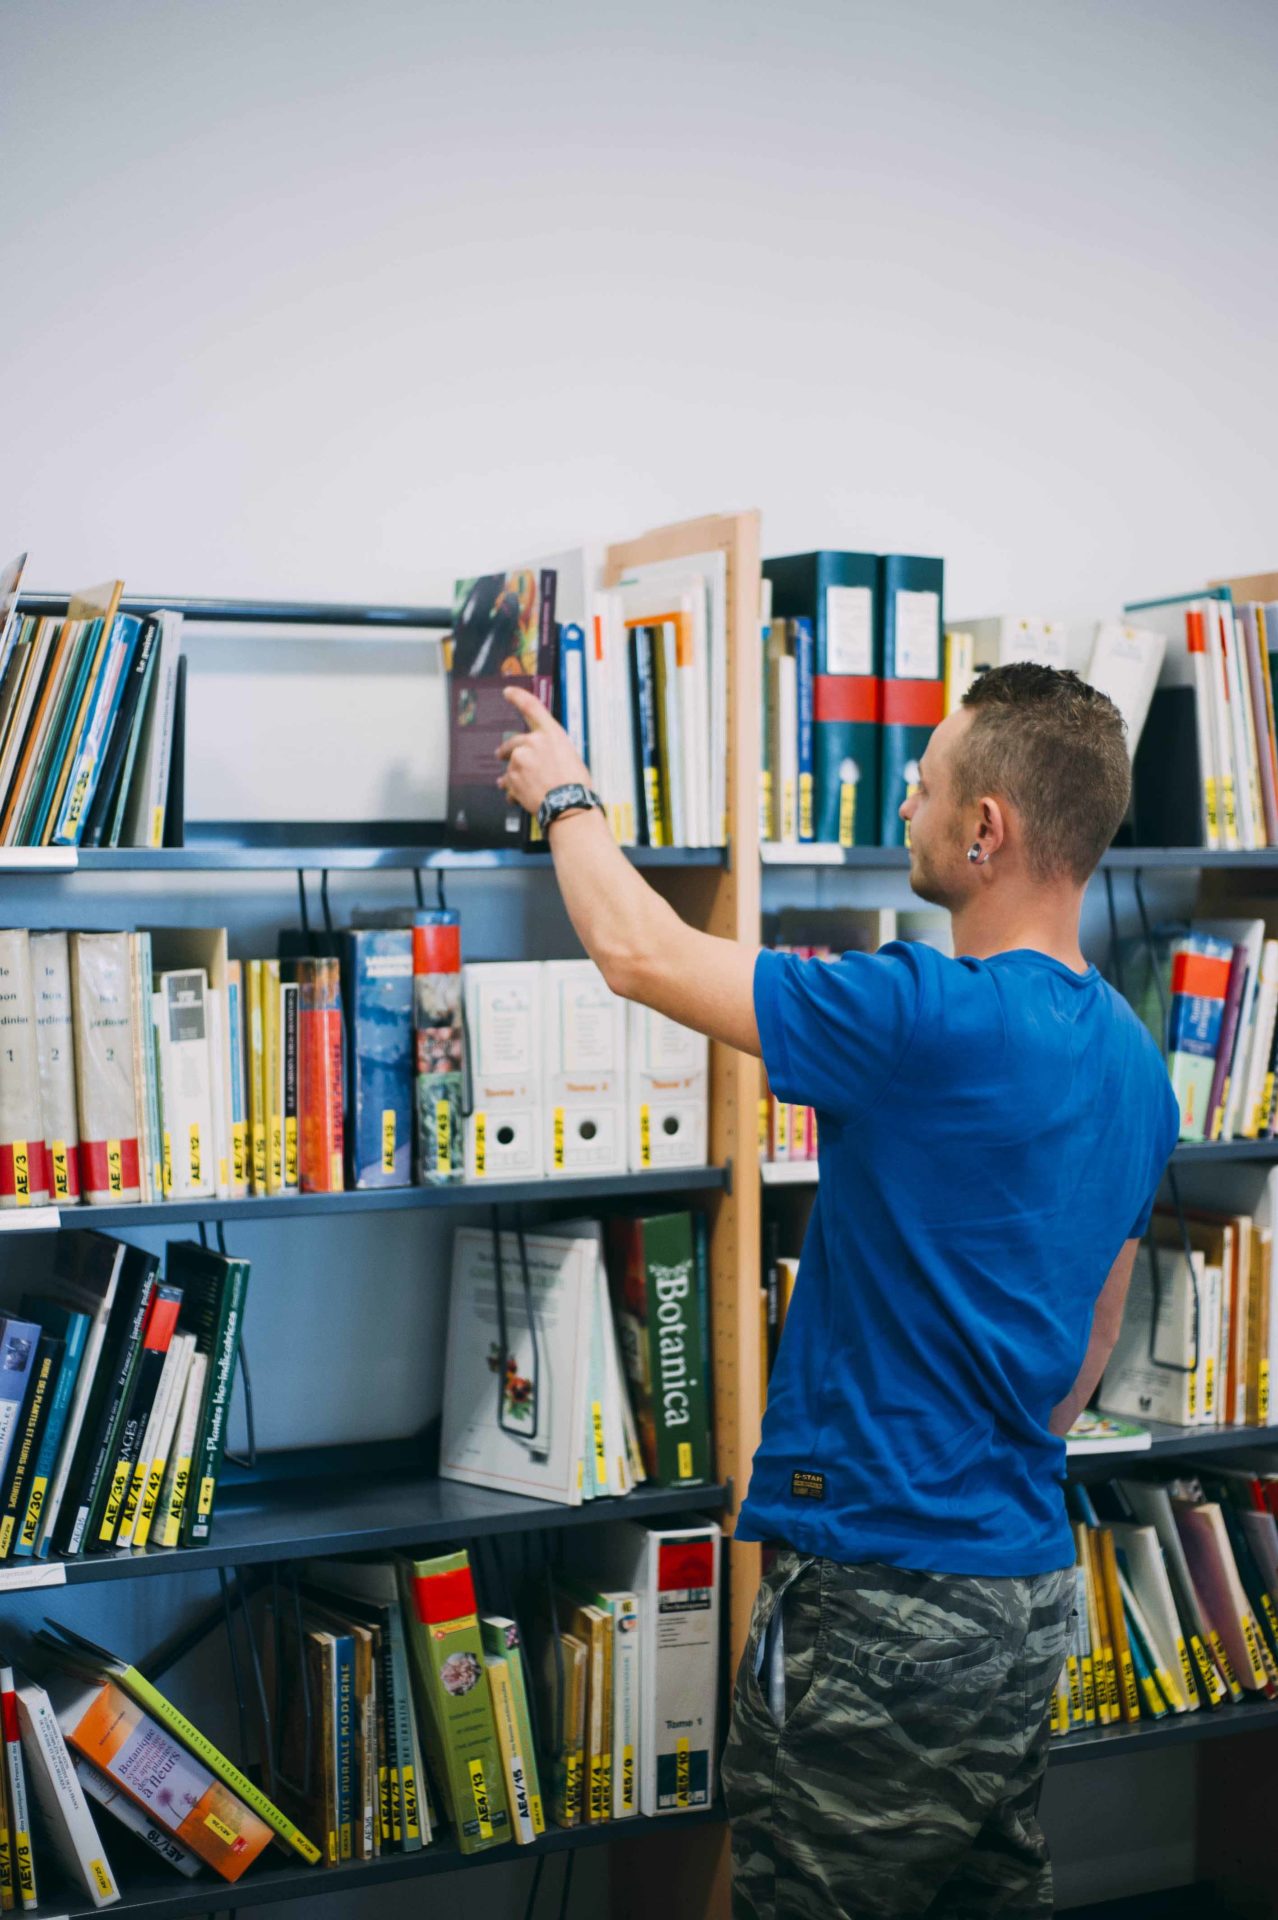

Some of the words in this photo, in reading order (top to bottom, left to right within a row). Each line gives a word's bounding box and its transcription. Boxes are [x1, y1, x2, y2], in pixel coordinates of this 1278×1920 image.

[7, 1049, 13, 1061] 1
[51, 1048, 59, 1060] 2
[14, 1154, 29, 1195] AE/3
[53, 1154, 68, 1194] AE/4
[107, 1151, 123, 1191] AE/5
[189, 1136, 201, 1179] AE/12
[232, 1136, 244, 1179] AE/17
[130, 1306, 145, 1340] jardins
[141, 1270, 155, 1306] publics
[38, 1357, 52, 1379] GUIDE
[213, 1310, 237, 1404] bio-indicatrices
[656, 1276, 698, 1428] Botanica
[35, 1379, 47, 1395] DES
[24, 1428, 35, 1438] ET
[27, 1394, 43, 1428] PLANTES
[206, 1405, 222, 1452] Plantes
[15, 1464, 26, 1475] DE
[17, 1437, 32, 1465] FLEURS
[22, 1489, 43, 1541] AE/30
[105, 1473, 126, 1524] AE/36
[122, 1474, 143, 1521] AE/41
[140, 1470, 161, 1519] AE/42
[169, 1469, 187, 1519] AE/46
[339, 1662, 350, 1736] MODERNE
[159, 1701, 212, 1753] CHLOROPHYLLE
[665, 1720, 693, 1729] Tome
[697, 1717, 703, 1726] 1
[116, 1726, 158, 1775] Botanique
[123, 1733, 163, 1781] systématique
[147, 1748, 183, 1789] fleurs
[150, 1742, 174, 1773] plantes
[340, 1740, 350, 1792] RURALE
[471, 1771, 490, 1823] AE4/13
[511, 1767, 529, 1818] AE4/15
[676, 1750, 688, 1800] AE5/10
[341, 1797, 351, 1821] VIE
[402, 1778, 418, 1826] AE4/8
[17, 1845, 33, 1891] AE1/8
[144, 1828, 185, 1864] AE1/19
